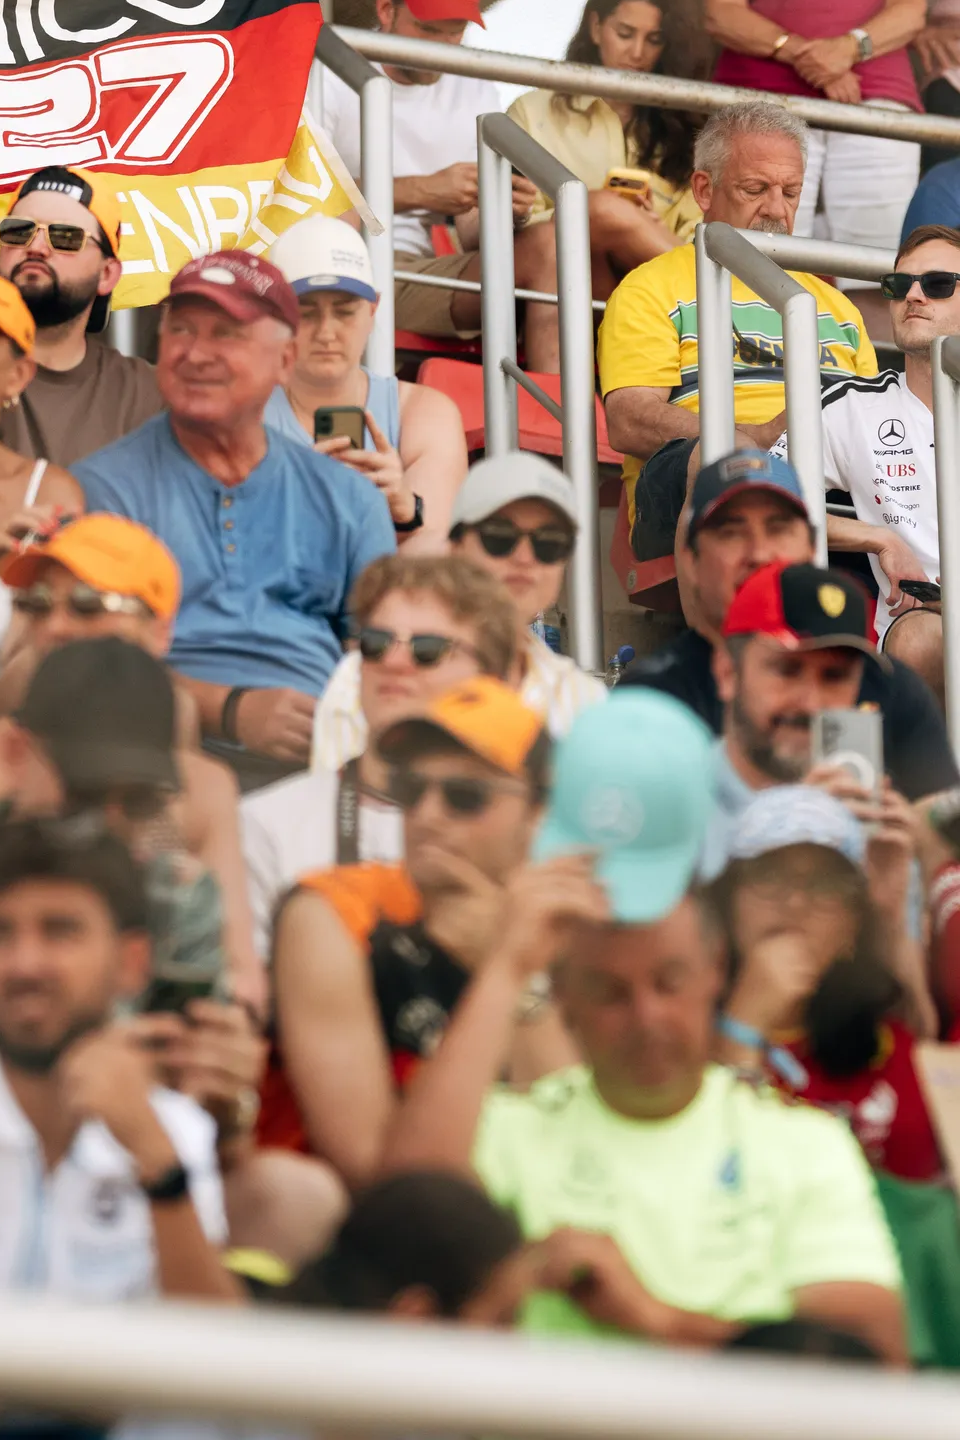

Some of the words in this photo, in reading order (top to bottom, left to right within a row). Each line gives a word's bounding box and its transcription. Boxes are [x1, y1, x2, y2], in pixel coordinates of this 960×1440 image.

[880, 448, 914, 456] AMG
[886, 463, 916, 478] UBS
[874, 478, 921, 492] CRDSTRIKE
